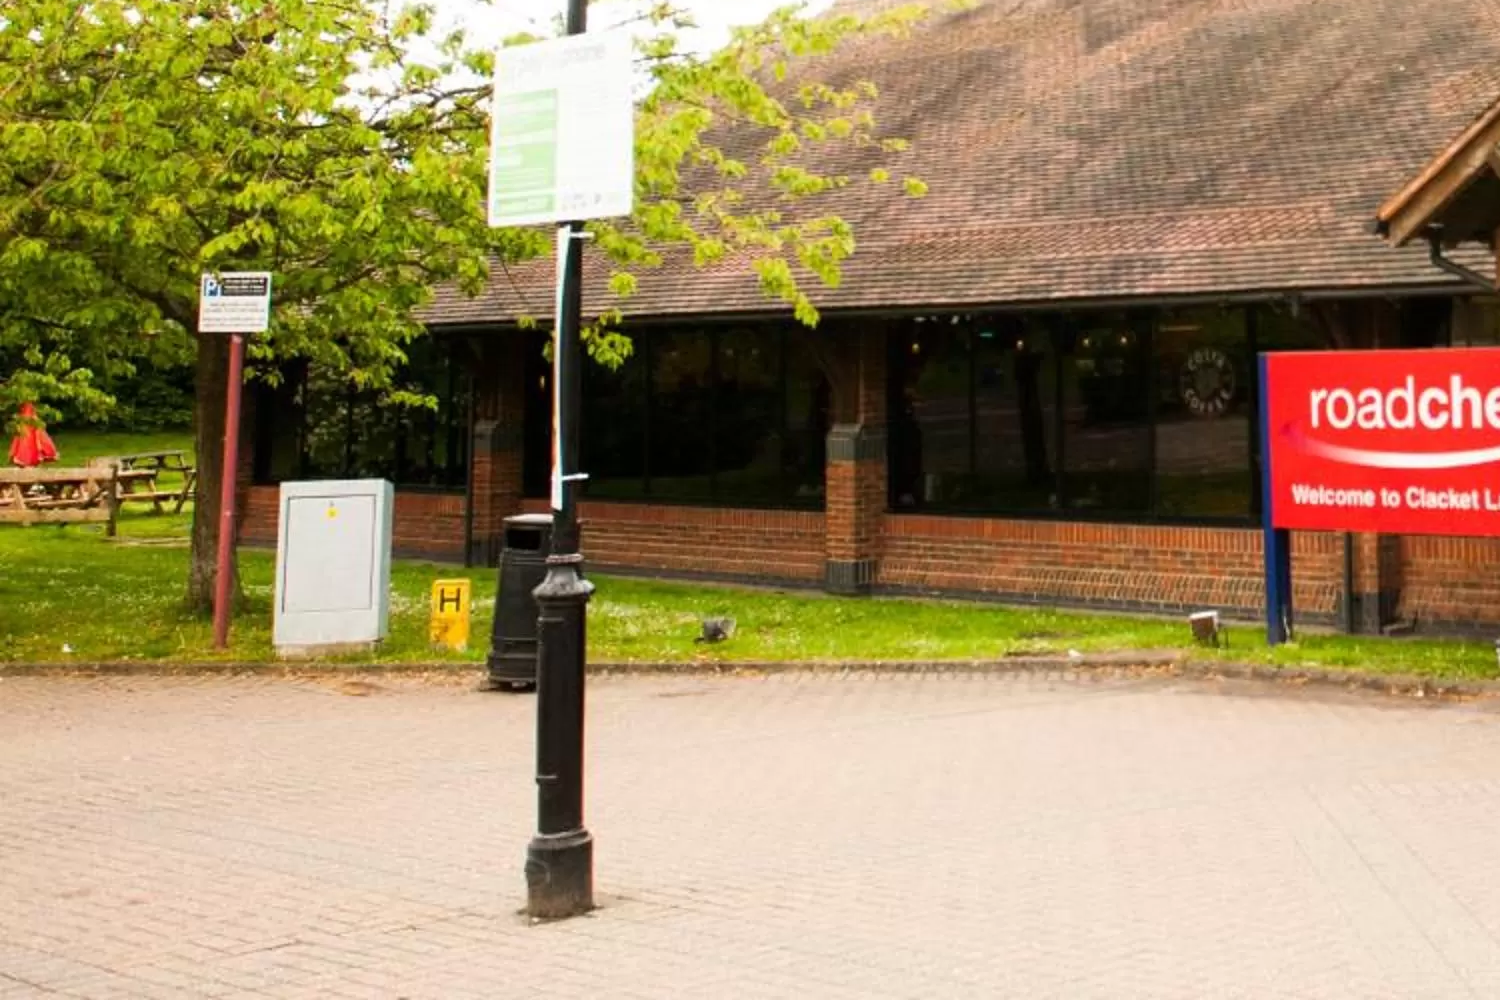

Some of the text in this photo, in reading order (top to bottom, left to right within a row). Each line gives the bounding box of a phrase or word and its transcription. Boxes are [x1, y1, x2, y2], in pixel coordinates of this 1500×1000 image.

[1290, 483, 1376, 507] Welcome
[1380, 487, 1401, 507] to
[1405, 487, 1480, 510] Clacket
[439, 587, 461, 613] H
